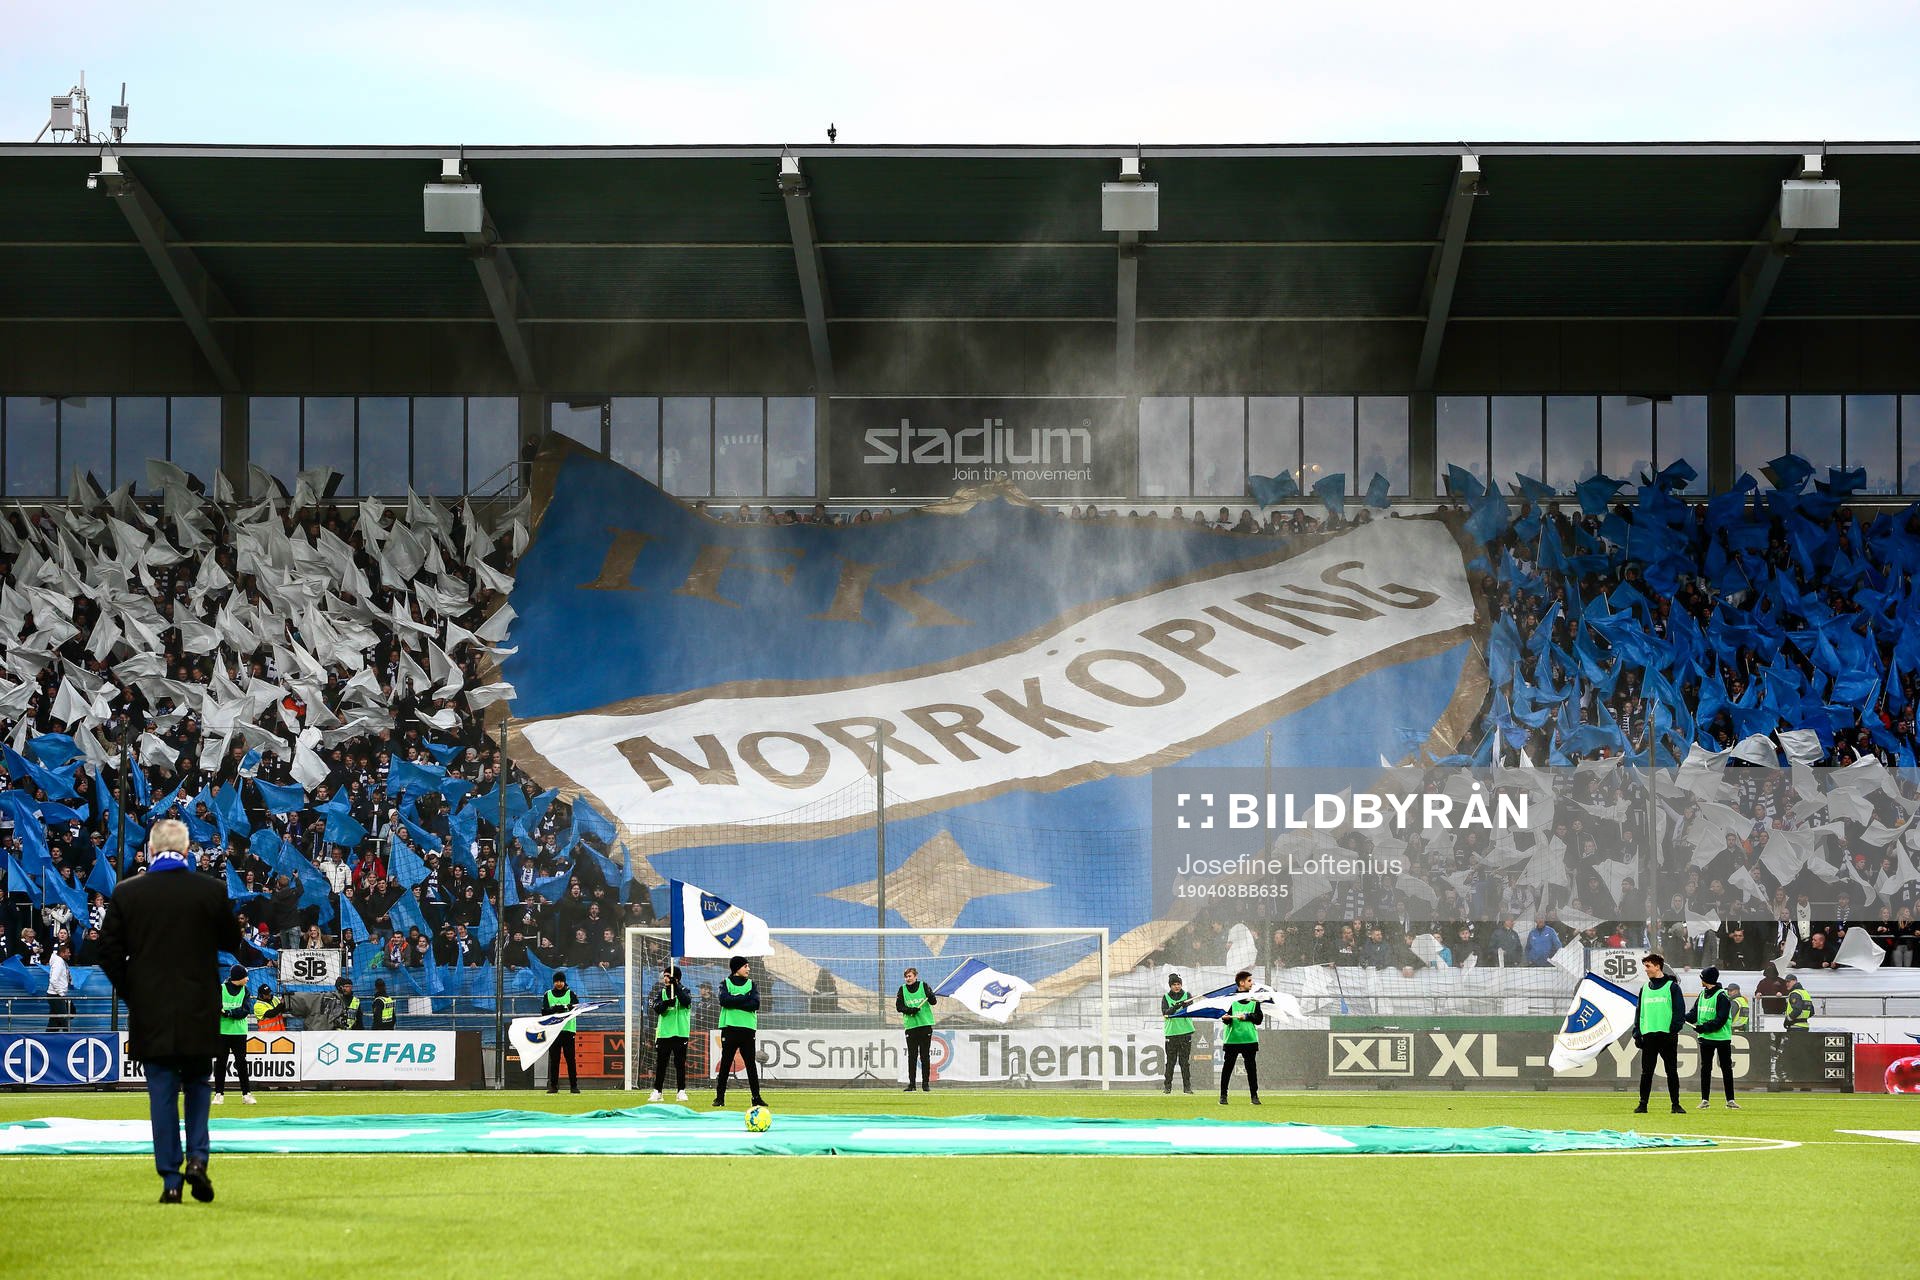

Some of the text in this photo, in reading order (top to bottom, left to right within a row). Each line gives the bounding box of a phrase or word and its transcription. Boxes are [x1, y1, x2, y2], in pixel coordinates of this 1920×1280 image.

[864, 419, 1091, 463] stadium
[952, 467, 1091, 481] Join the movement
[576, 526, 989, 627] IFK
[613, 560, 1441, 793] NORRKÖPING
[345, 1043, 436, 1063] SEFAB
[761, 1039, 897, 1068] DS Smith
[969, 1034, 1166, 1077] Thermia
[1335, 1039, 1407, 1070] XL
